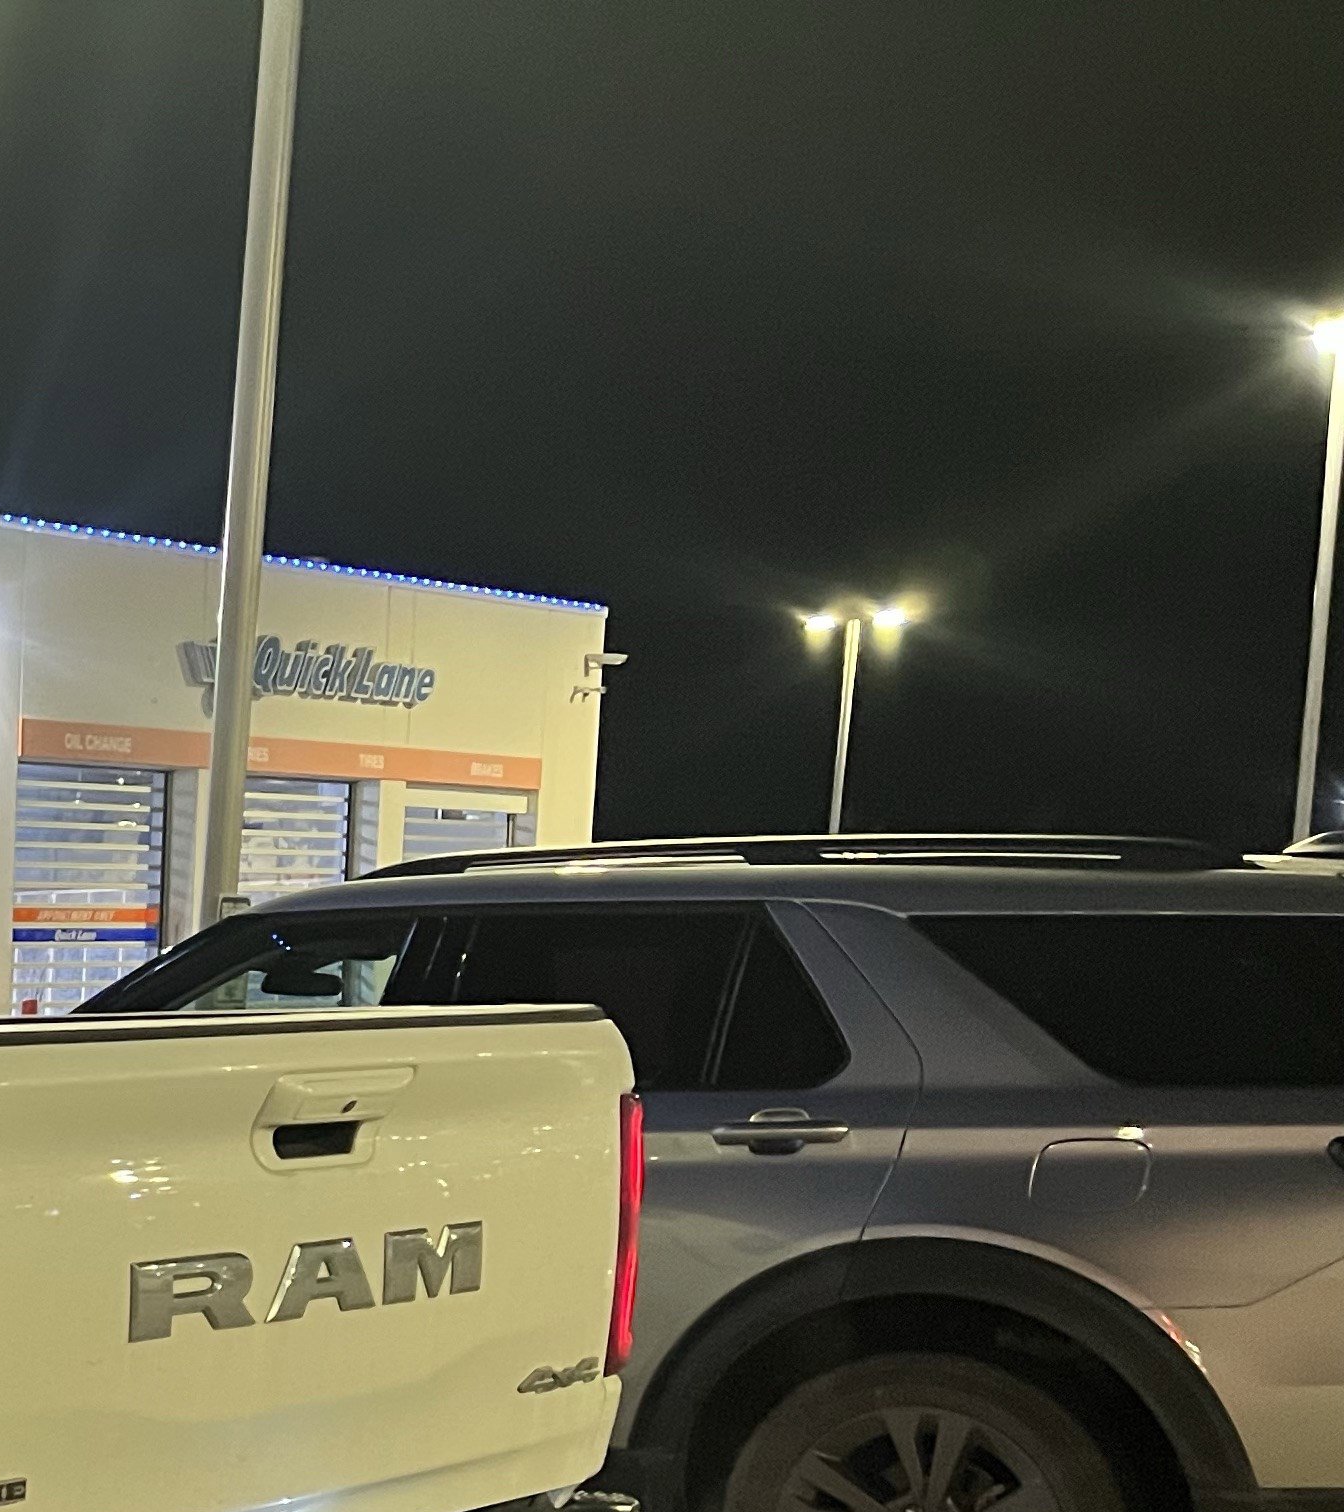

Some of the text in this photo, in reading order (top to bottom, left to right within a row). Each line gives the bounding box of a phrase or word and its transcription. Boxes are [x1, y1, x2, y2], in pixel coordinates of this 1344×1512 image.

[252, 634, 436, 703] Quick Lane
[64, 733, 131, 753] OIL CHANGE
[128, 1220, 483, 1343] RAM
